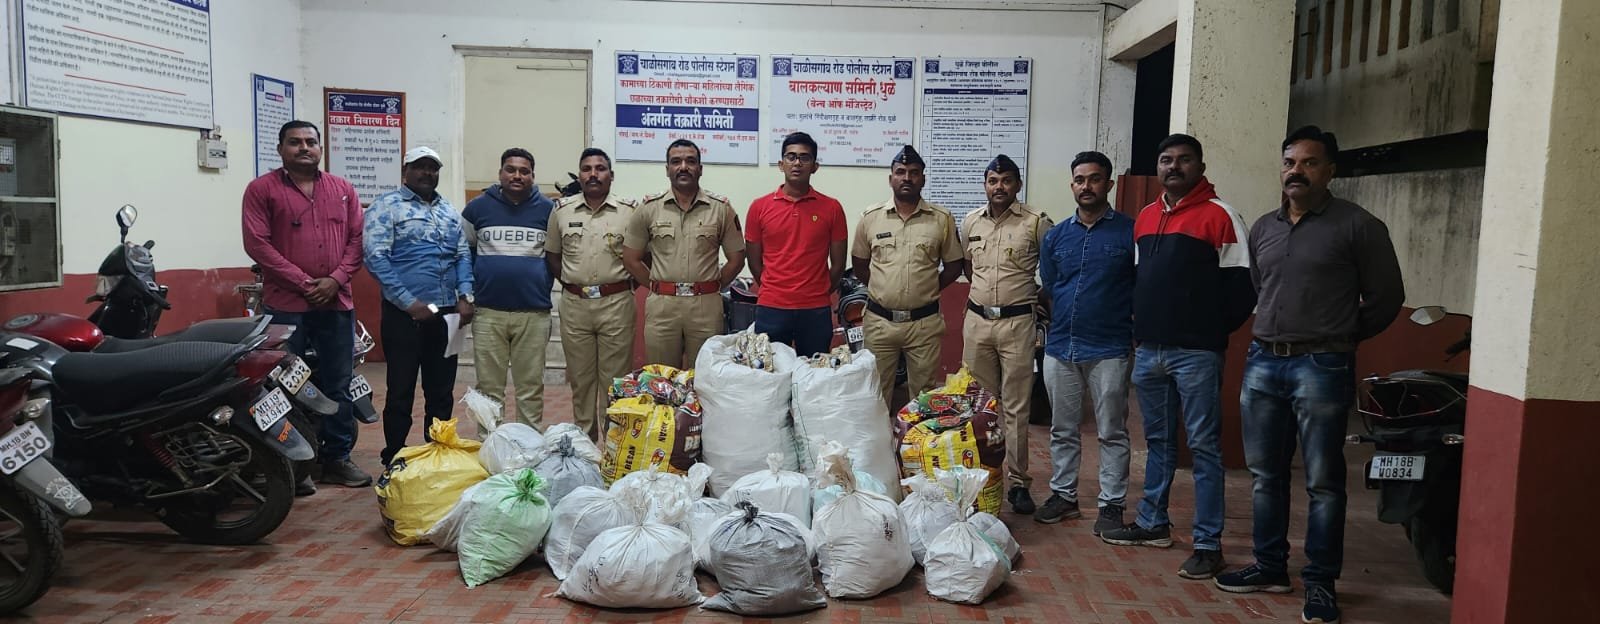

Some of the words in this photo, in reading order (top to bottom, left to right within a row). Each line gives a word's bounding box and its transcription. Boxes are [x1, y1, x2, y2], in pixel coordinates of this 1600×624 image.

[678, 56, 690, 71] रोड
[691, 56, 714, 72] पोलीस
[716, 58, 735, 72] स्टेशन
[833, 59, 844, 74] रोड
[846, 59, 869, 74] पोलीस
[872, 60, 892, 75] स्टेशन
[789, 80, 842, 95] बालकल्याण
[329, 115, 351, 124] तक्रार
[354, 114, 383, 126] निवारण
[386, 115, 400, 127] दिन
[641, 107, 671, 127] अंतर्गत
[674, 108, 701, 128] तक्रारी
[704, 109, 735, 129] समिती
[2, 437, 46, 470] 6150
